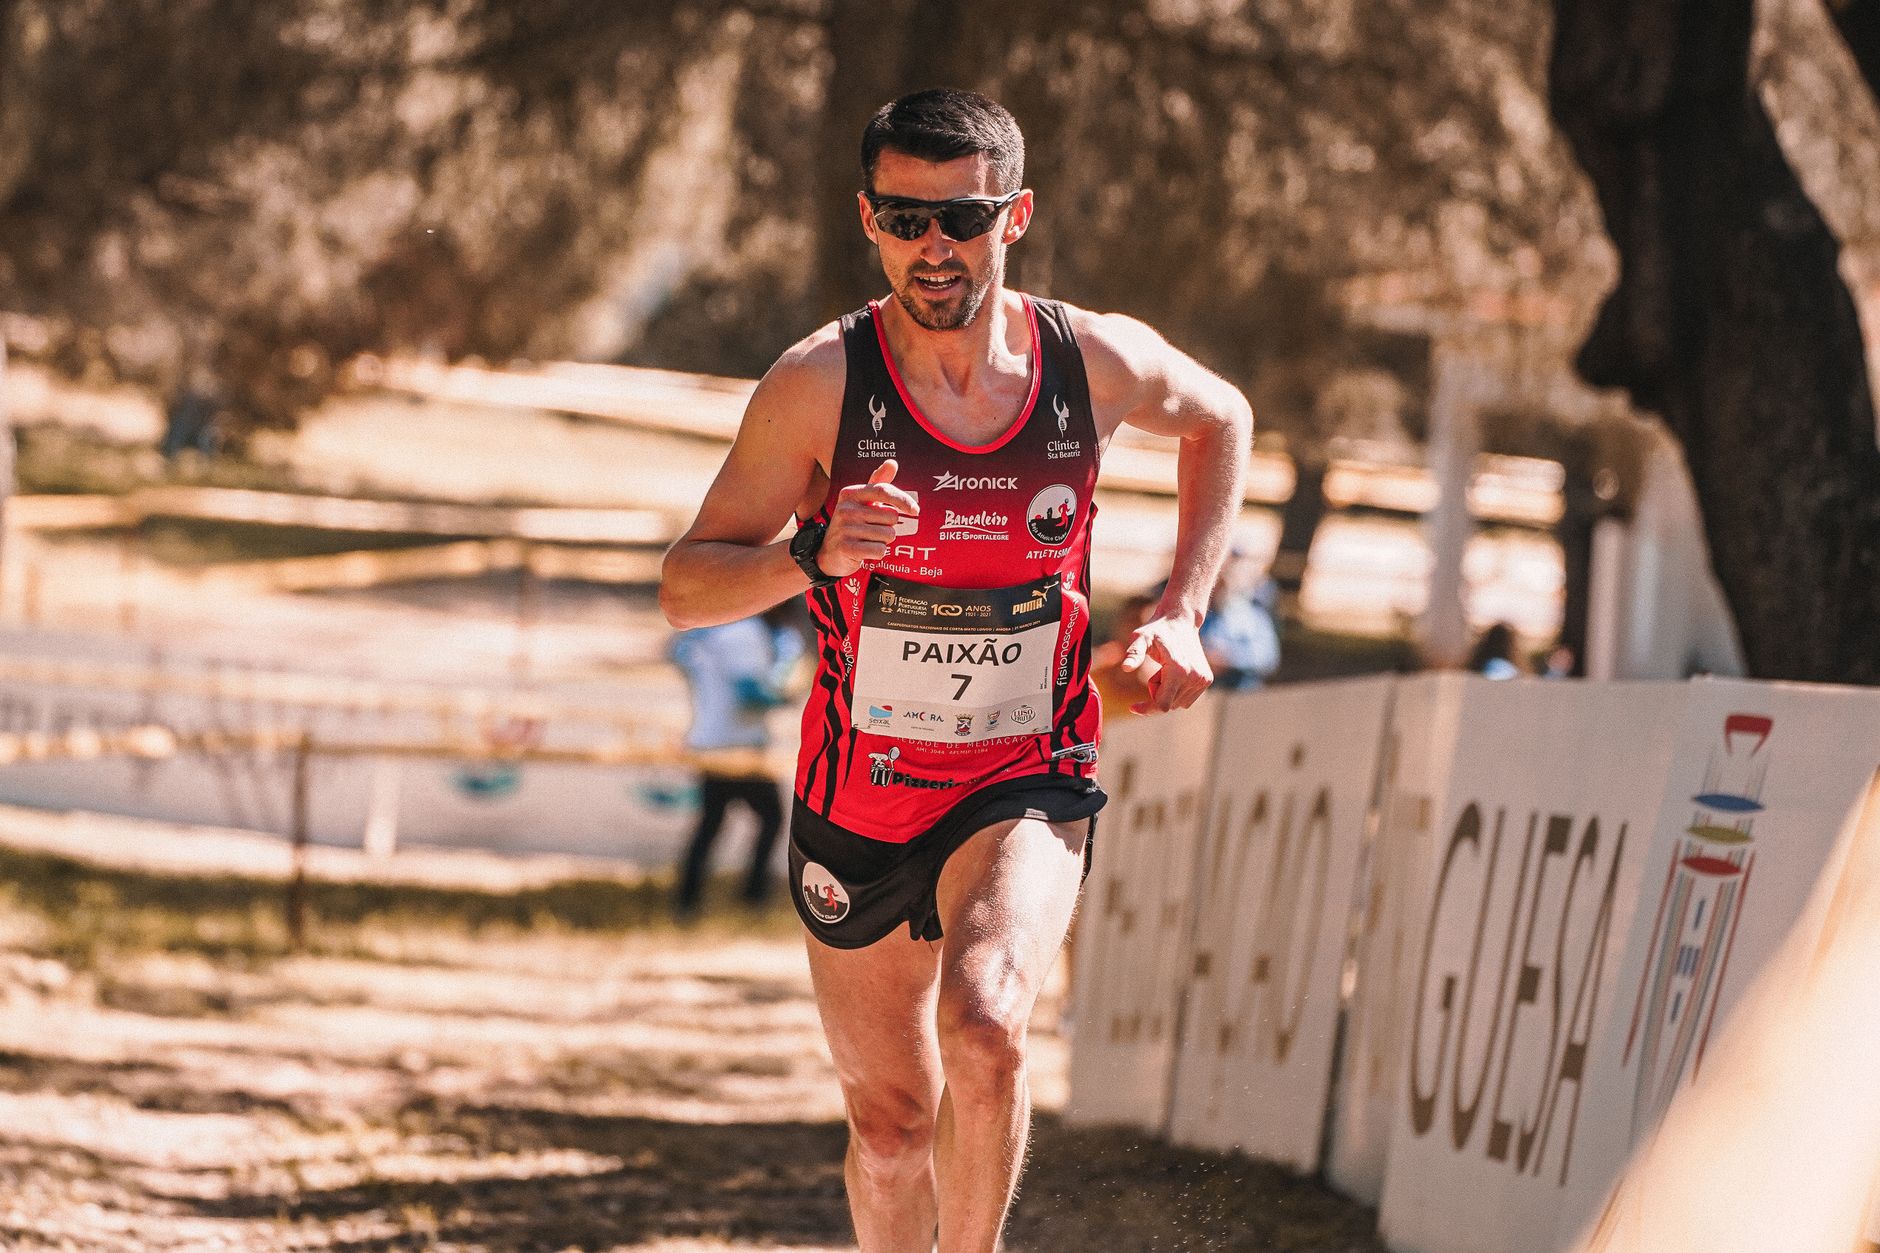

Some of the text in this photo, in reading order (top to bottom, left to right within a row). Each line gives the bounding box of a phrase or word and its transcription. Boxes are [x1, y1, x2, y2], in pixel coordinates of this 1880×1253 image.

[857, 439, 896, 450] Clínica
[857, 450, 870, 458] Sta
[1047, 449, 1081, 460] Sta Beatriz
[944, 509, 1009, 527] Bancaleiro
[884, 545, 937, 561] EAT
[1025, 546, 1072, 560] ATLETISM
[919, 566, 943, 578] Beja
[965, 605, 993, 613] ANOS
[1012, 598, 1044, 616] PUMA
[902, 638, 1022, 666] PAIXÃO
[950, 673, 973, 701] 7
[892, 771, 962, 790] Pizzeri
